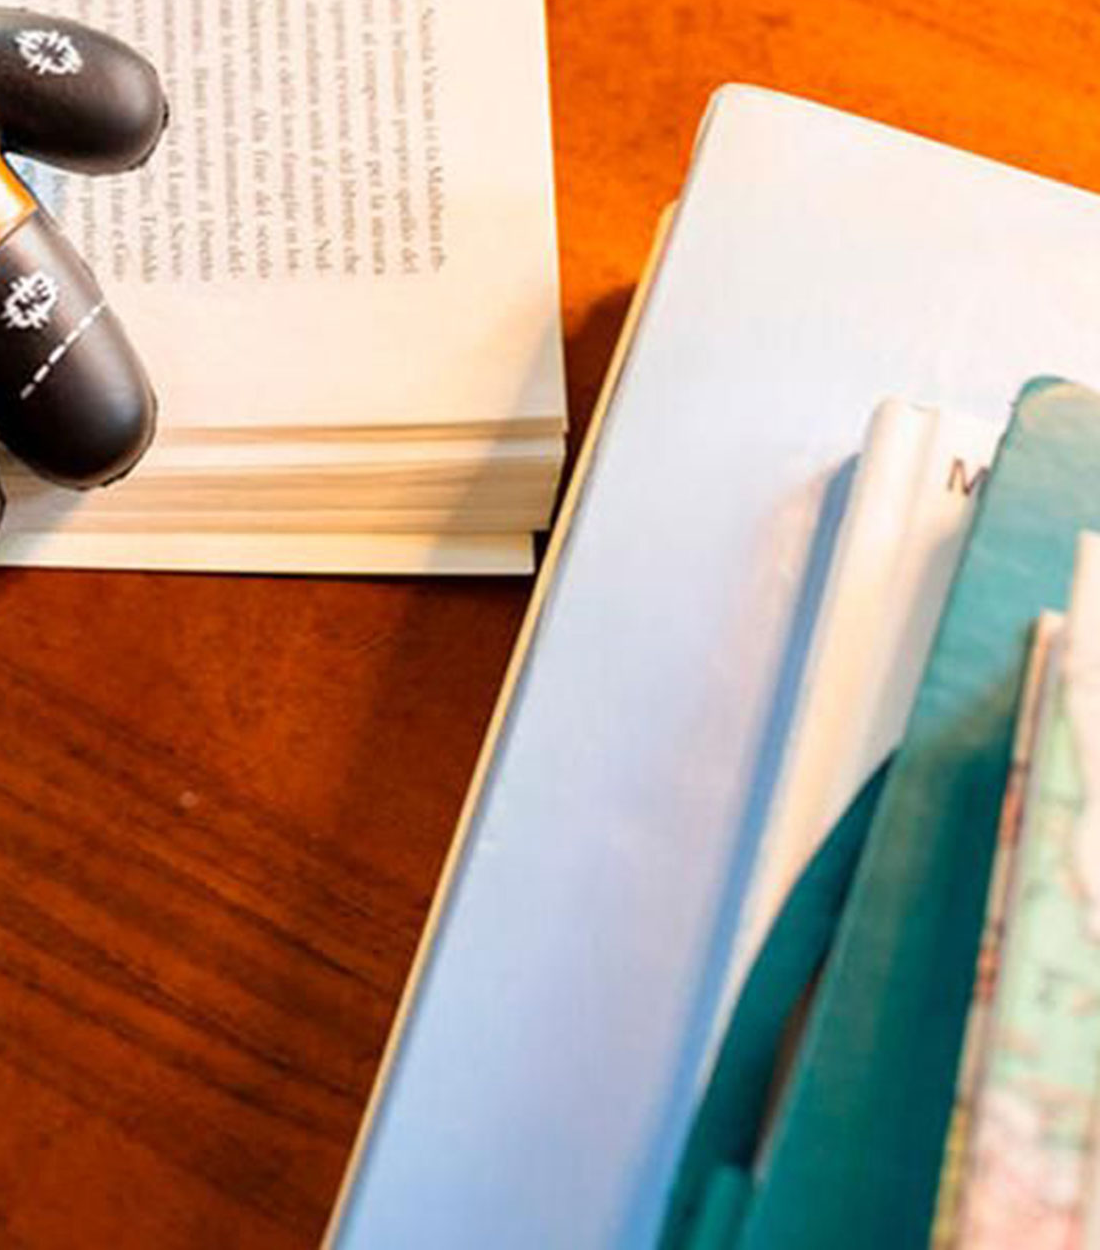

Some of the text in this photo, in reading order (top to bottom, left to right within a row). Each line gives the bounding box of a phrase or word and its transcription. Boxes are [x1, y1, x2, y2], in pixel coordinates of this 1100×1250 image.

[250, 108, 271, 144] Alla
[252, 150, 273, 184] fine
[338, 147, 358, 174] del
[279, 152, 301, 221] famiglie
[254, 190, 274, 217] del
[255, 223, 274, 279] secolo
[343, 246, 363, 275] che
[401, 247, 420, 274] del
